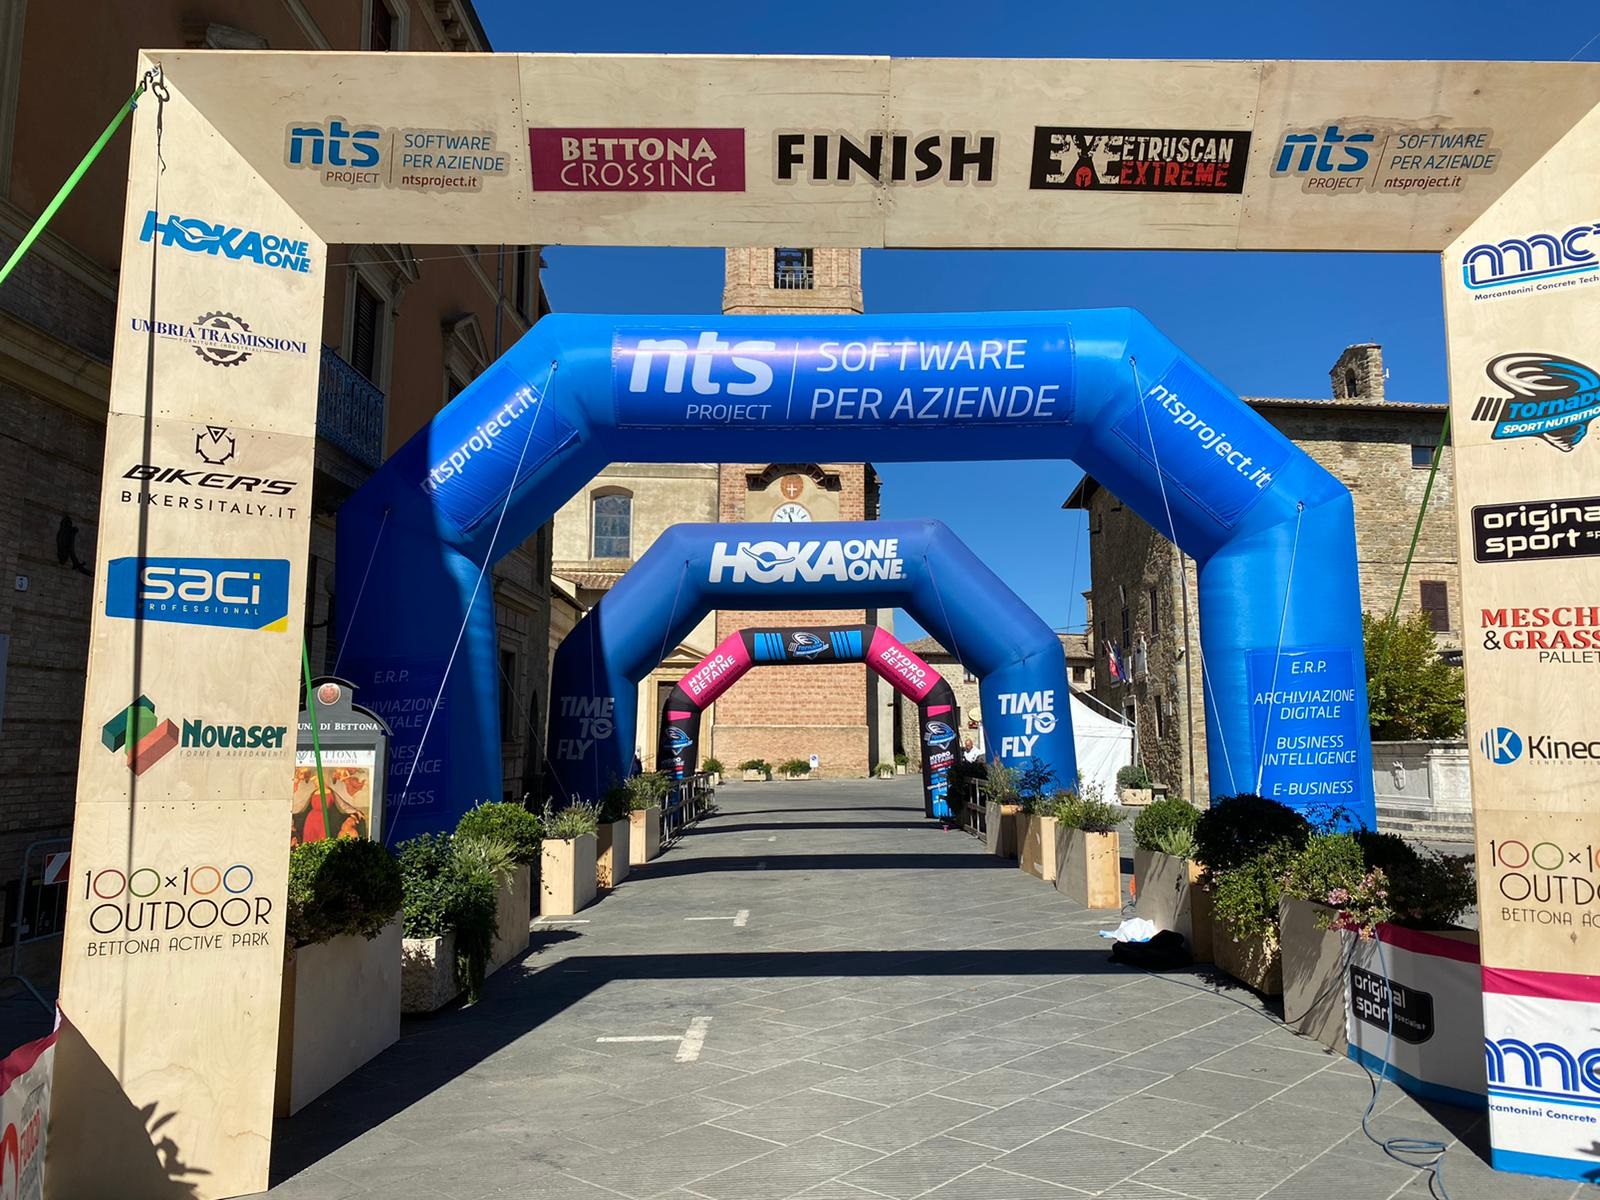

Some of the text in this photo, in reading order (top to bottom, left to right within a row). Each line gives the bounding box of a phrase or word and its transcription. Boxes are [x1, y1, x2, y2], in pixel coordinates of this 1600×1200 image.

[290, 121, 380, 168] nts
[404, 134, 492, 151] SOFTWARE
[561, 137, 718, 162] BETTONA
[1122, 135, 1234, 163] ETRUSCAN
[1276, 125, 1376, 173] nts
[1396, 133, 1488, 150] SOFTWARE
[402, 154, 505, 172] PER AZIENDE
[777, 134, 996, 183] FINISH
[1389, 153, 1497, 171] PER AZIENDE
[326, 171, 380, 185] PROJECT
[402, 175, 477, 189] ntsproject.it
[560, 161, 716, 188] CROSSING
[1119, 160, 1231, 187] EXTREME
[1307, 176, 1365, 189] PROJECT
[1384, 175, 1462, 190] ntsproject.it
[139, 210, 264, 265] HOKA
[262, 234, 309, 257] ONE
[264, 251, 312, 274] ONE
[1474, 285, 1534, 301] Marcantonini
[1536, 278, 1577, 291] Concrete
[131, 318, 307, 354] UMBRIA TRASMISSIONI
[628, 331, 776, 396] nts
[815, 338, 1028, 373] SOFTWARE
[685, 403, 773, 421] PROJECT
[810, 384, 1061, 421] PER AZIENDE
[1149, 384, 1273, 489] ntsproject.it
[1502, 421, 1545, 434] SPORT
[419, 385, 538, 495] ntsproject.it
[121, 464, 298, 496] BIKER'S
[121, 490, 297, 520] BIKERSITALY.IT
[844, 538, 899, 560] ONE
[1485, 529, 1581, 559] sport
[708, 540, 849, 584] HOKA
[848, 557, 903, 581] ONE
[139, 566, 261, 605] saci
[139, 603, 259, 616] ROFESSIONAL
[688, 654, 724, 688] HYDRO
[880, 651, 927, 690] BETAINE
[887, 646, 926, 678] HYDRO
[1291, 660, 1327, 675] E.R.P.
[692, 655, 736, 696] BETAINE
[560, 696, 615, 718] TIME
[998, 690, 1054, 716] TIME
[1254, 689, 1355, 705] ARCHIVIAZIONE
[1022, 711, 1057, 735] TO
[1280, 705, 1341, 720] DIGITALE
[181, 717, 288, 749] Novaser
[320, 723, 331, 731] DI
[334, 722, 379, 731] BETTONA
[556, 739, 594, 761] FLY
[1001, 734, 1040, 758] FLY
[1276, 735, 1344, 750] BUSINESS
[1264, 750, 1356, 766] INTELLIGENCE
[1273, 780, 1354, 796] E-BUSINESS
[1500, 872, 1600, 906] OUTD
[89, 897, 273, 934] OUTDOOR
[1501, 907, 1573, 926] BETTONA
[87, 932, 270, 957] BETTONA ACTIVE PARK
[1546, 1109, 1597, 1124] Concrete
